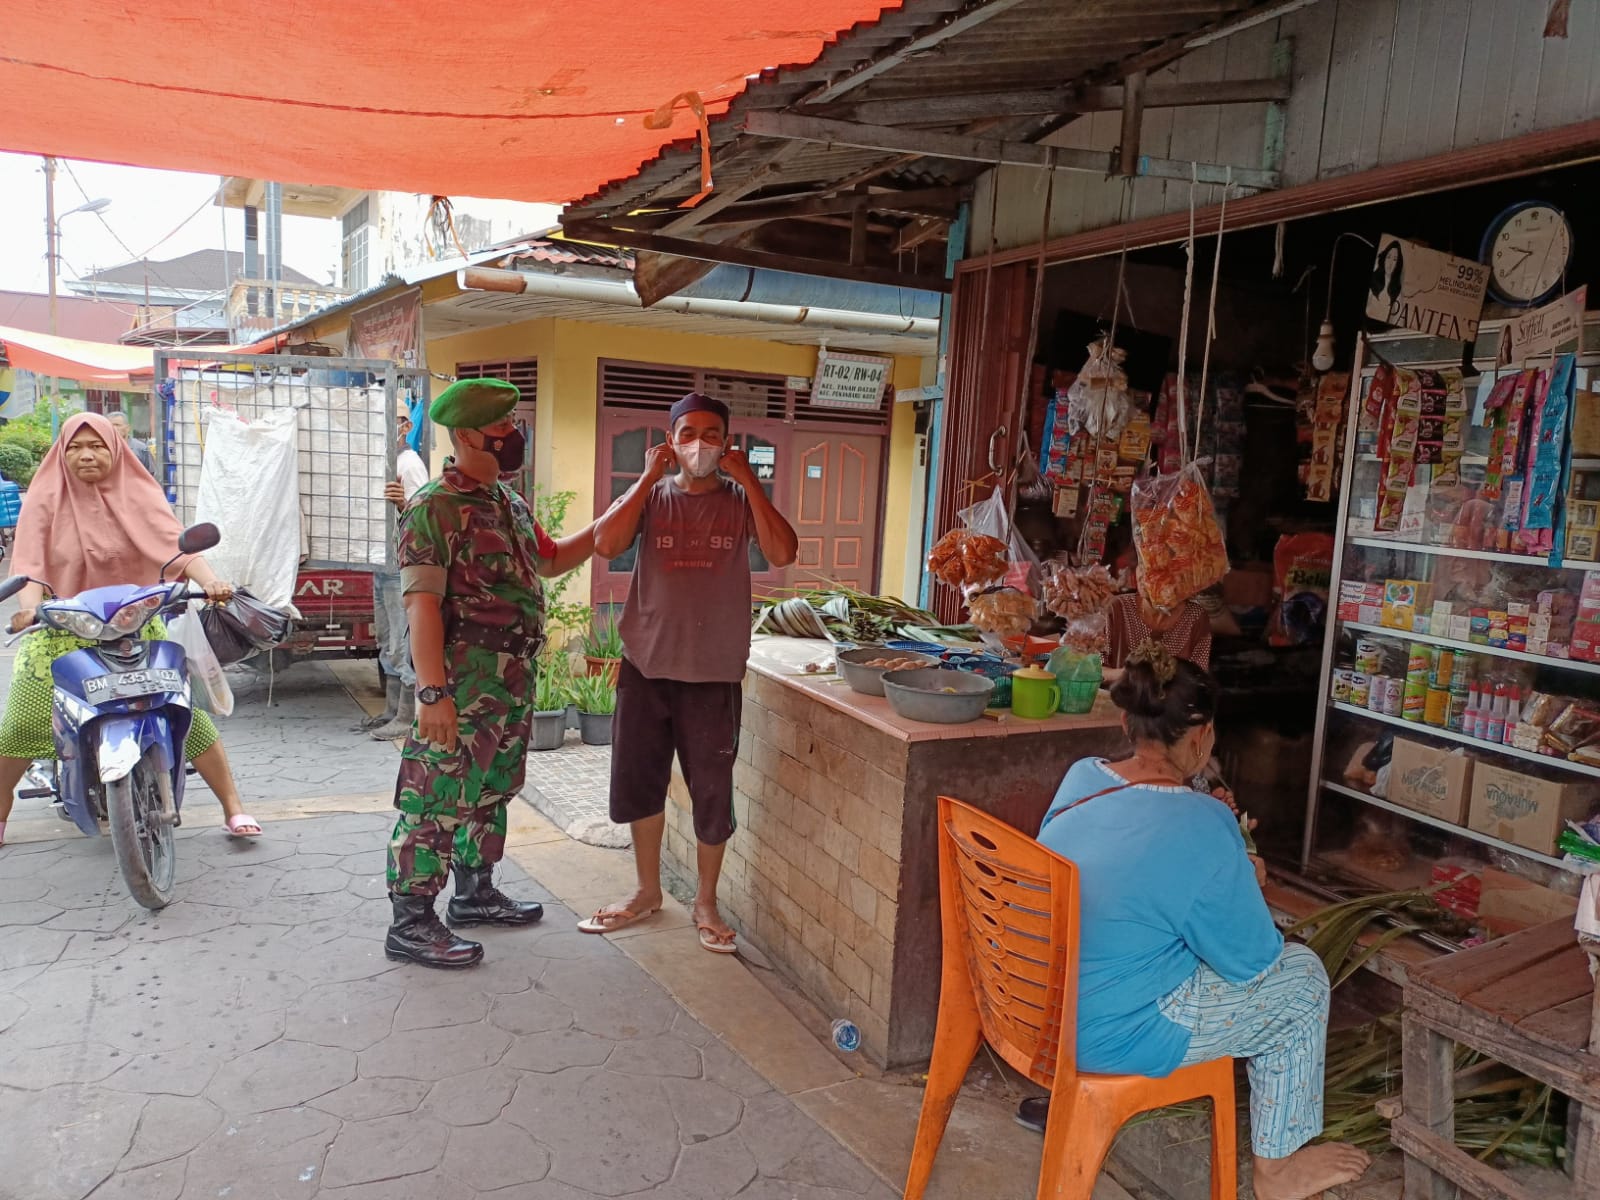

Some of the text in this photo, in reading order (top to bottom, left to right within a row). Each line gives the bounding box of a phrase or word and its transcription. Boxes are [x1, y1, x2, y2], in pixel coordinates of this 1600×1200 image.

[1457, 265, 1484, 284] 99%
[1439, 276, 1482, 293] MELINDUNGI
[655, 535, 674, 549] 19
[709, 535, 734, 550] 96
[296, 578, 344, 596] AR
[86, 678, 109, 693] BM
[118, 671, 153, 686] 4351
